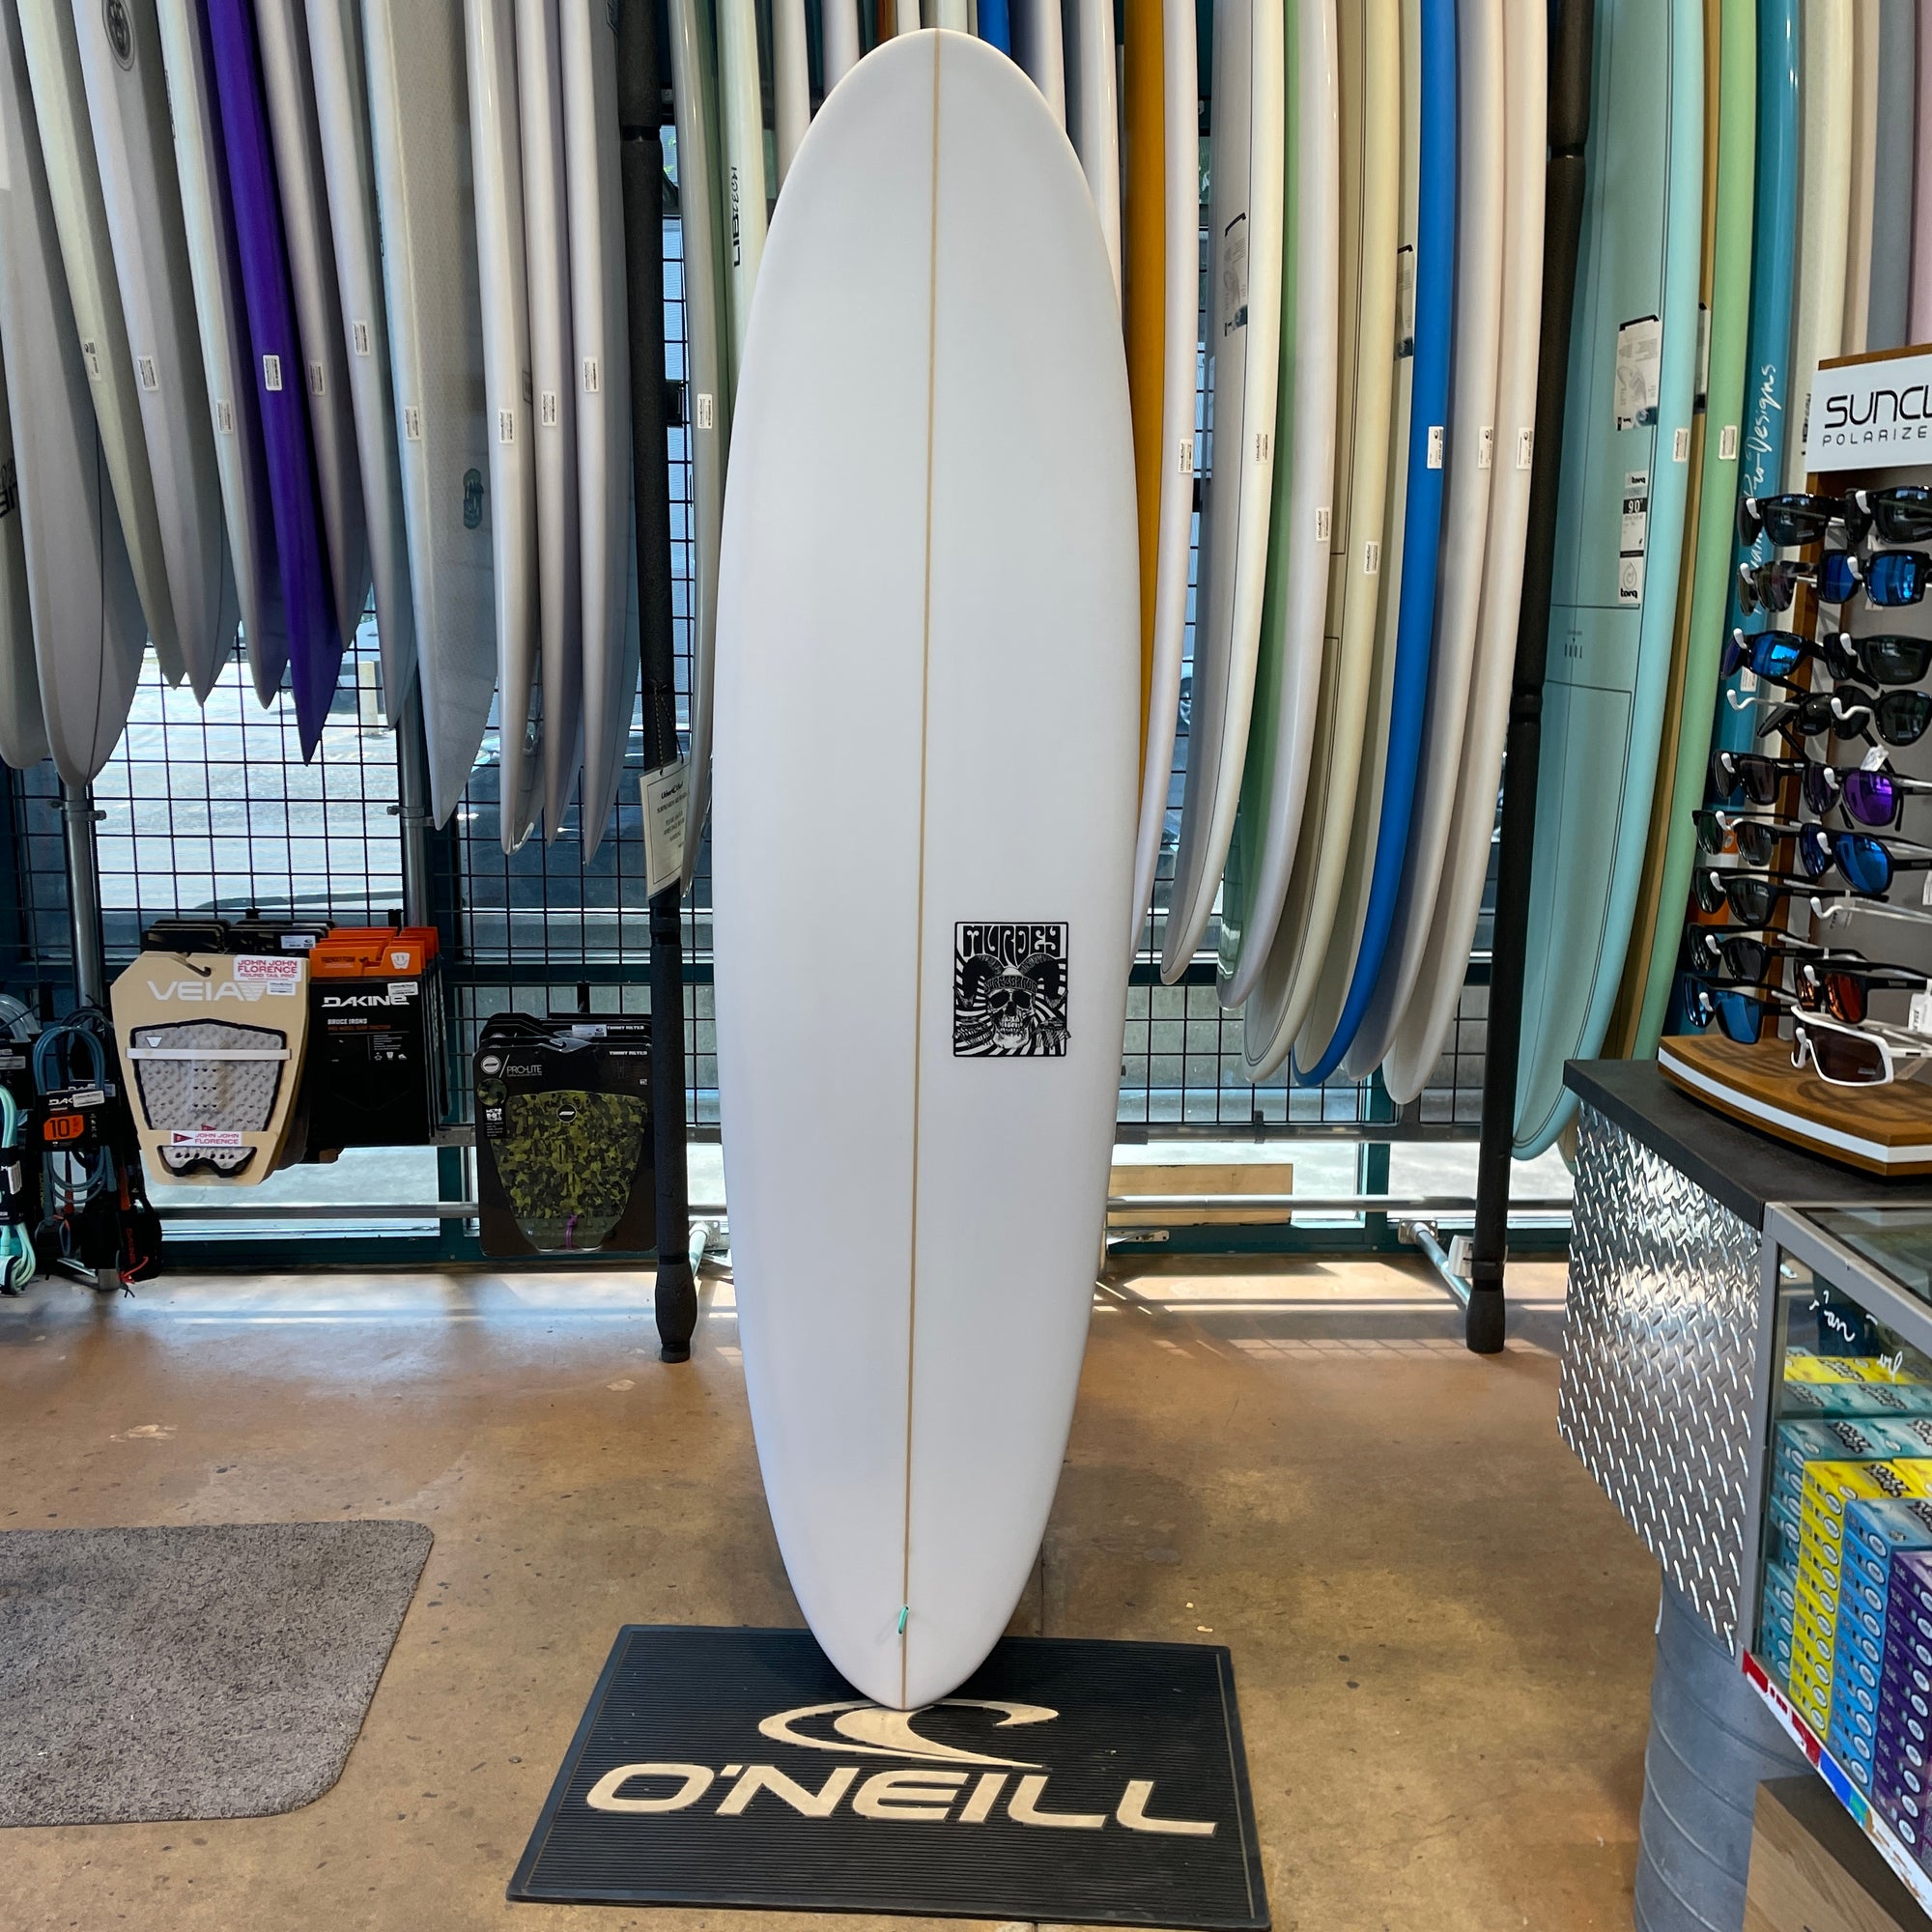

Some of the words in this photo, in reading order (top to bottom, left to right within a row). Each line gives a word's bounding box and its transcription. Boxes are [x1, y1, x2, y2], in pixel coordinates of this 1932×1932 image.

[1620, 587, 1638, 599] torq
[321, 995, 410, 1008] DAKINE
[506, 1064, 543, 1074] PRO-LITE
[49, 1118, 71, 1138] 10
[585, 1761, 1217, 1838] O'NEILL
